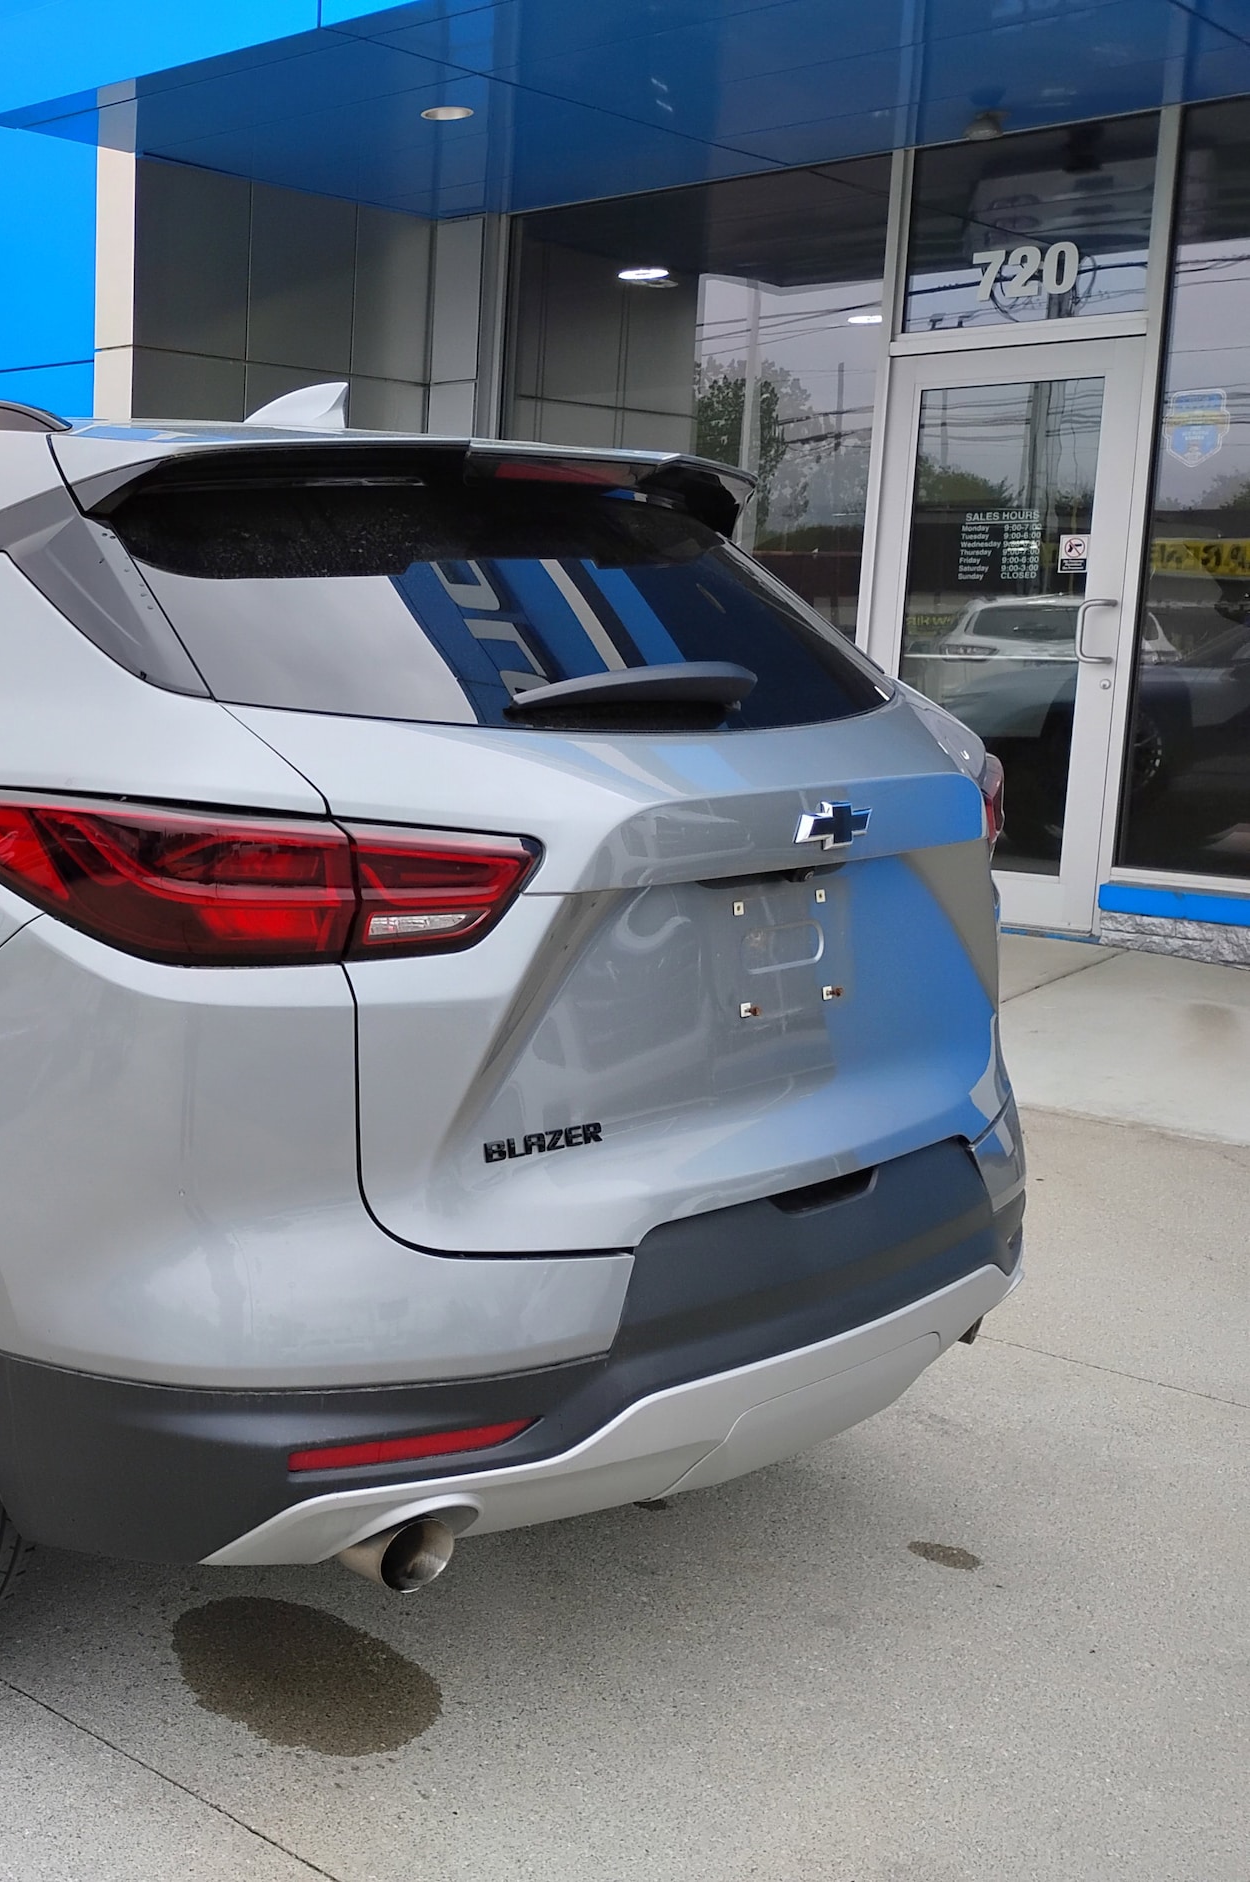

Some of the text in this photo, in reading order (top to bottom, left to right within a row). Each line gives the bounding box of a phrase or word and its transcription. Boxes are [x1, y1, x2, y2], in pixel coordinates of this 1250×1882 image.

[973, 241, 1079, 301] 720
[965, 510, 1040, 521] SALES HOURS
[483, 1122, 603, 1163] BLAZER
